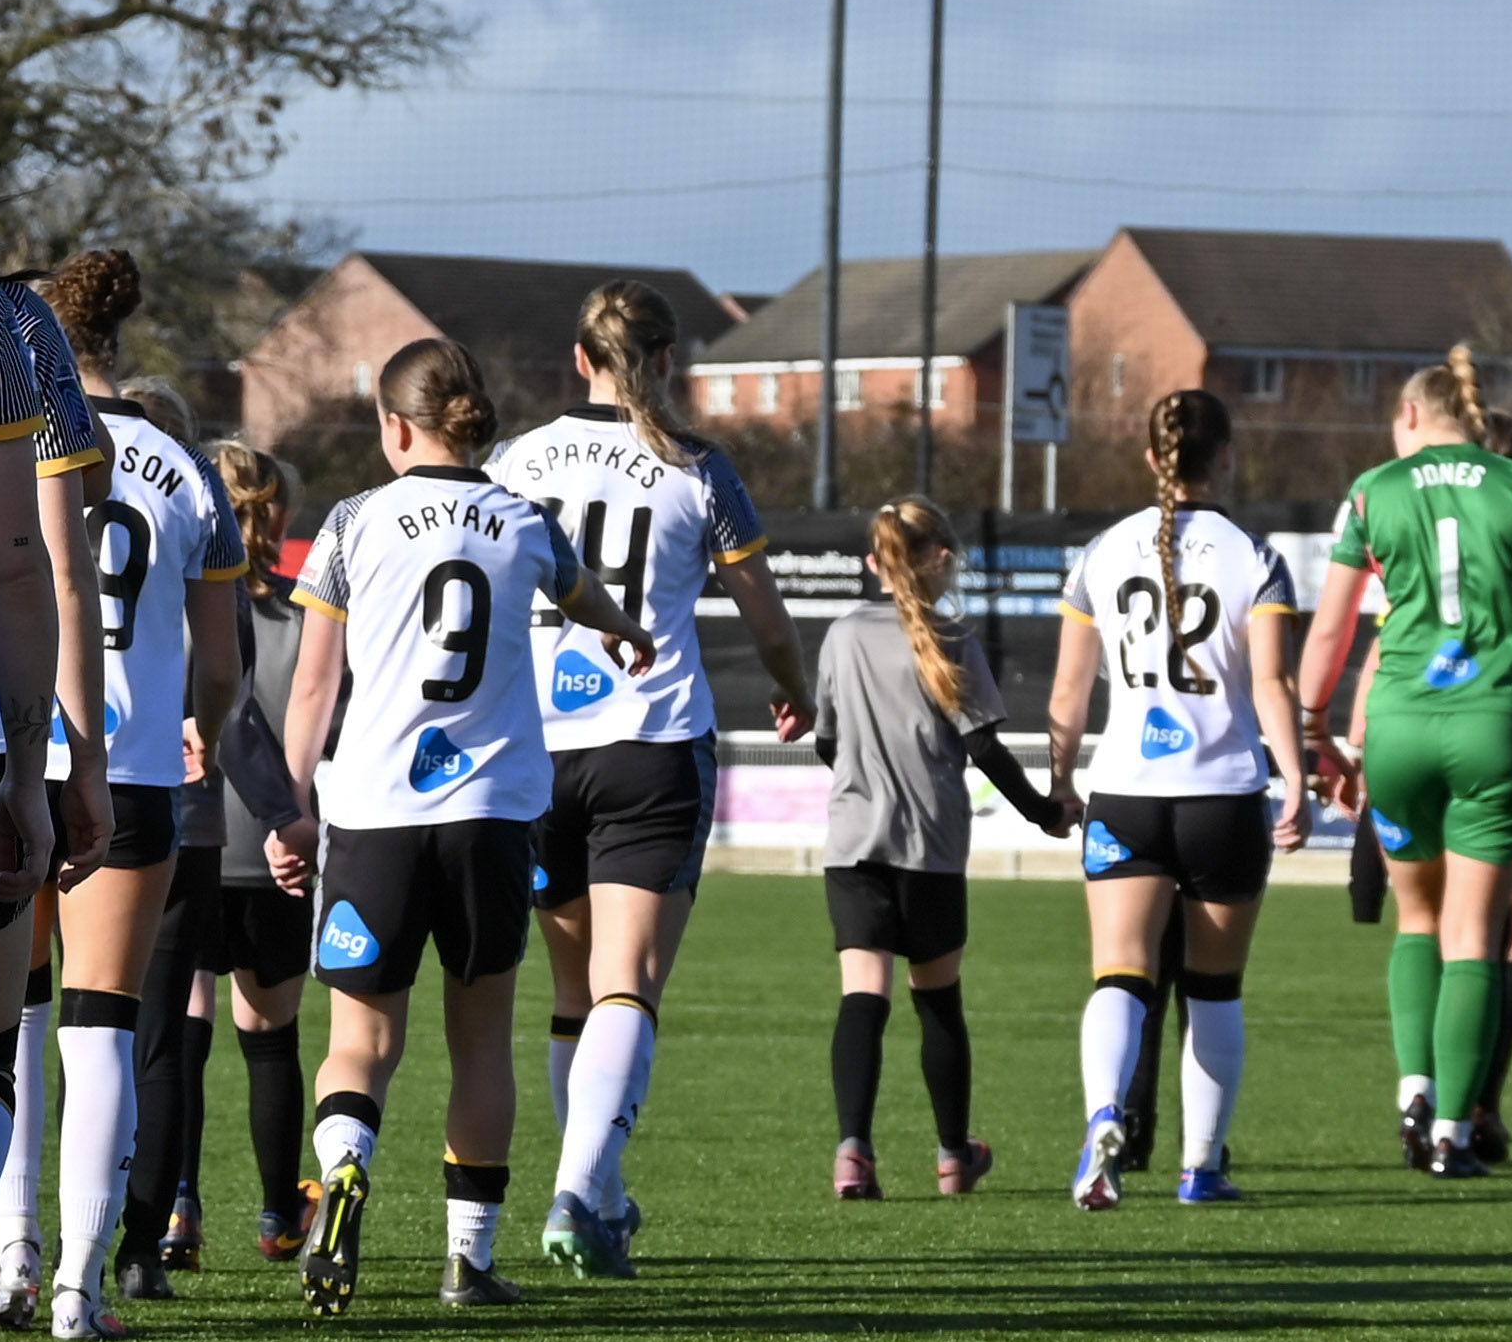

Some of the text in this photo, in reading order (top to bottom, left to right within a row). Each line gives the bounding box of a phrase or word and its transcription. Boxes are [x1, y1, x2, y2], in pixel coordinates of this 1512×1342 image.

[526, 443, 664, 489] SPARKES
[1410, 461, 1487, 490] JONES
[398, 501, 506, 542] BRYAN
[1435, 516, 1464, 625] 1
[421, 560, 492, 703] 9
[1116, 575, 1221, 695] 22
[557, 669, 602, 697] hsg
[1145, 723, 1184, 750] hsg
[416, 750, 460, 776] hsg
[324, 921, 368, 959] hsg
